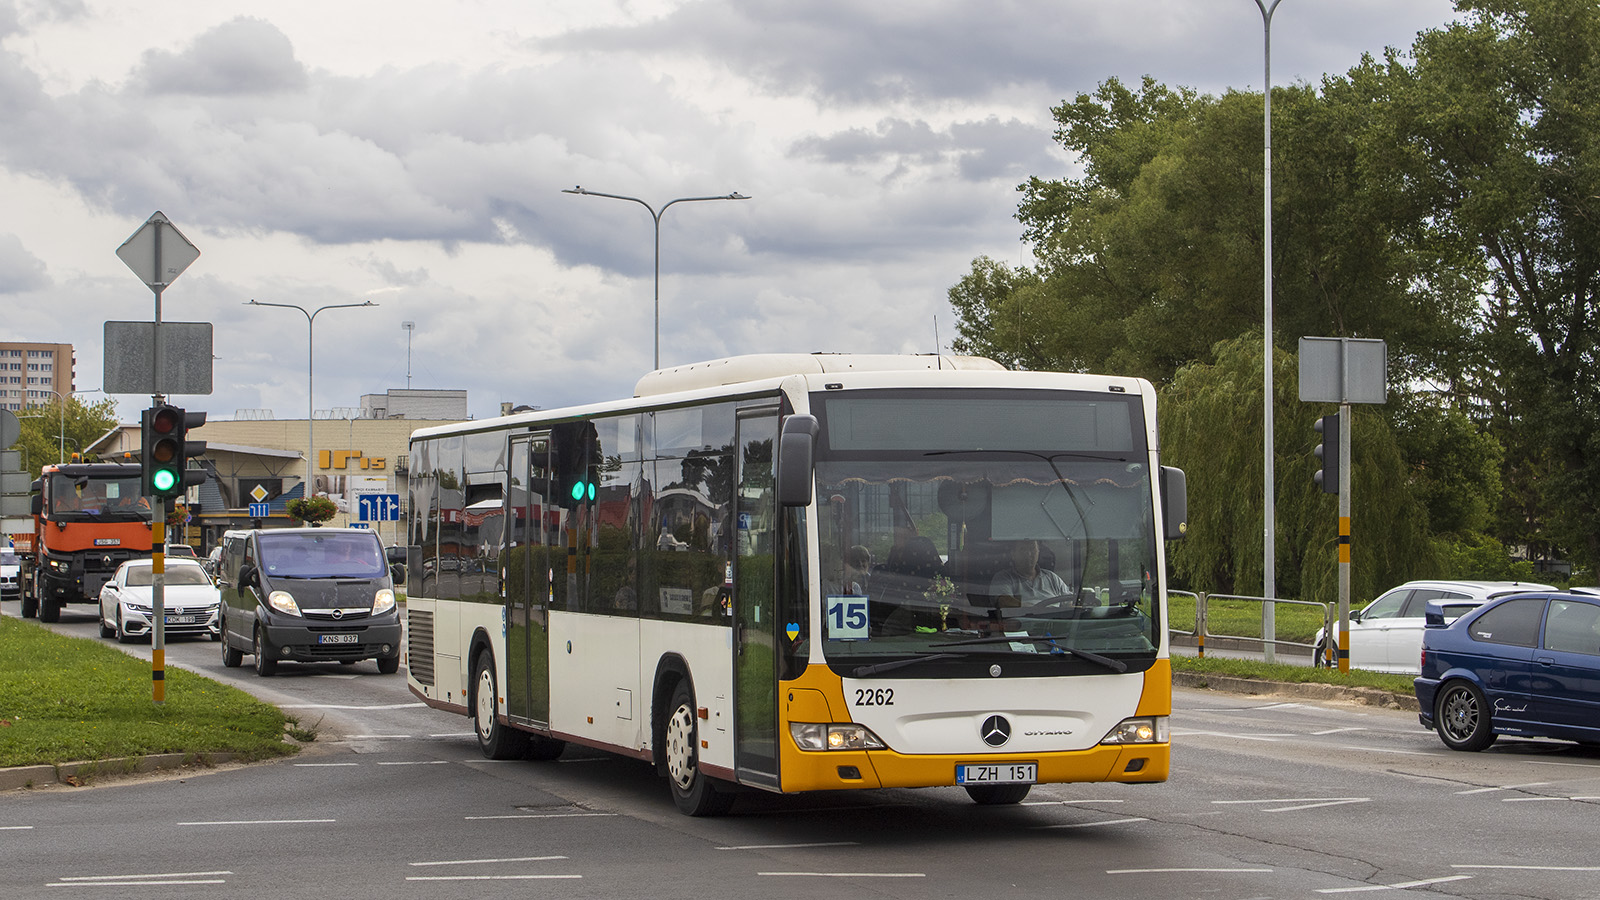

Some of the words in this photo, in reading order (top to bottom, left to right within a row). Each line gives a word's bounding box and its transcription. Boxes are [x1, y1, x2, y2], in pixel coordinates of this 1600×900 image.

[829, 602, 867, 630] 15
[322, 635, 340, 643] KNS
[343, 635, 358, 643] 037
[855, 688, 895, 706] 2262
[967, 766, 998, 781] LZH
[1010, 766, 1032, 780] 151
